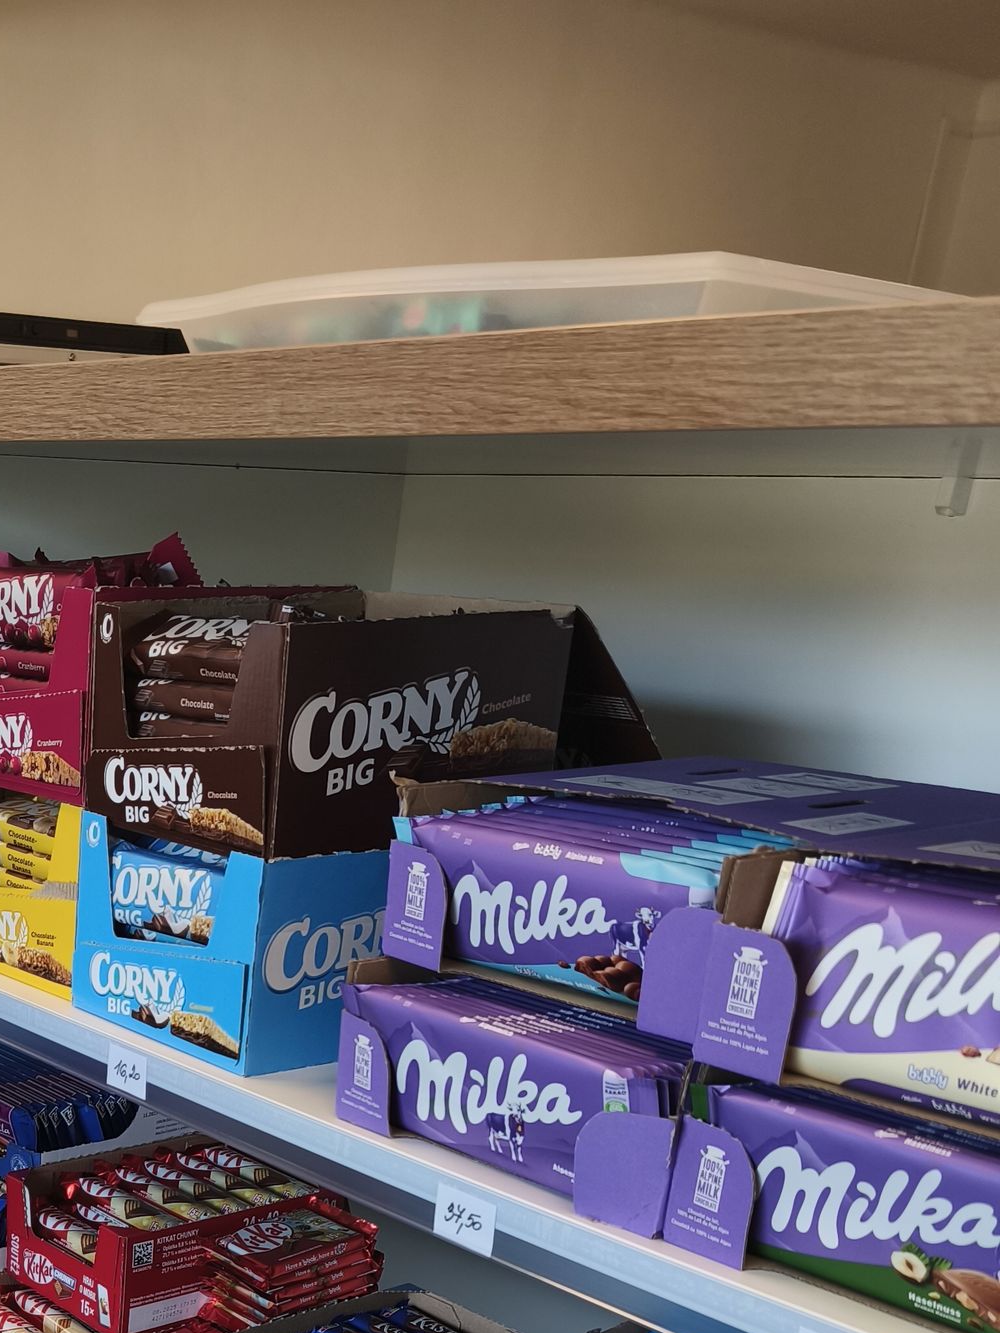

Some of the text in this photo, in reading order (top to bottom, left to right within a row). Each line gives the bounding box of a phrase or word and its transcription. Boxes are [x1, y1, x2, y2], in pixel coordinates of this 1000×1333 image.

[148, 640, 189, 657] BIG
[18, 661, 45, 672] Cranberry
[200, 668, 236, 680] Chocolate
[180, 699, 214, 710] Chocolate
[482, 693, 531, 714] Chocolate
[291, 669, 469, 773] CORNY
[104, 755, 194, 806] CORNY
[326, 758, 375, 796] BIG
[208, 791, 238, 799] Chocolate
[126, 806, 149, 823] BIG
[408, 892, 424, 909] MILK
[453, 875, 616, 954] Milka
[31, 931, 56, 939] Chocolate-
[90, 951, 177, 1005] CORNY
[736, 960, 761, 977] 100%
[733, 973, 759, 990] ALPINE
[298, 975, 346, 1010] BIG
[730, 986, 756, 1005] MILK
[107, 999, 131, 1015] BIG
[114, 1060, 140, 1082] 16,20
[397, 1040, 582, 1134] Milka
[958, 1078, 998, 1097] White
[703, 1156, 724, 1177] 100%
[697, 1178, 720, 1200] MILK
[700, 1171, 722, 1187] ALPINE
[756, 1146, 1000, 1249] Milka
[157, 1229, 199, 1245] KITKAT CHUNKY
[233, 1222, 288, 1253] KitKat
[27, 1253, 53, 1282] KitKat
[54, 1269, 75, 1289] CHUNKY
[909, 1292, 961, 1318] Haselnuss
